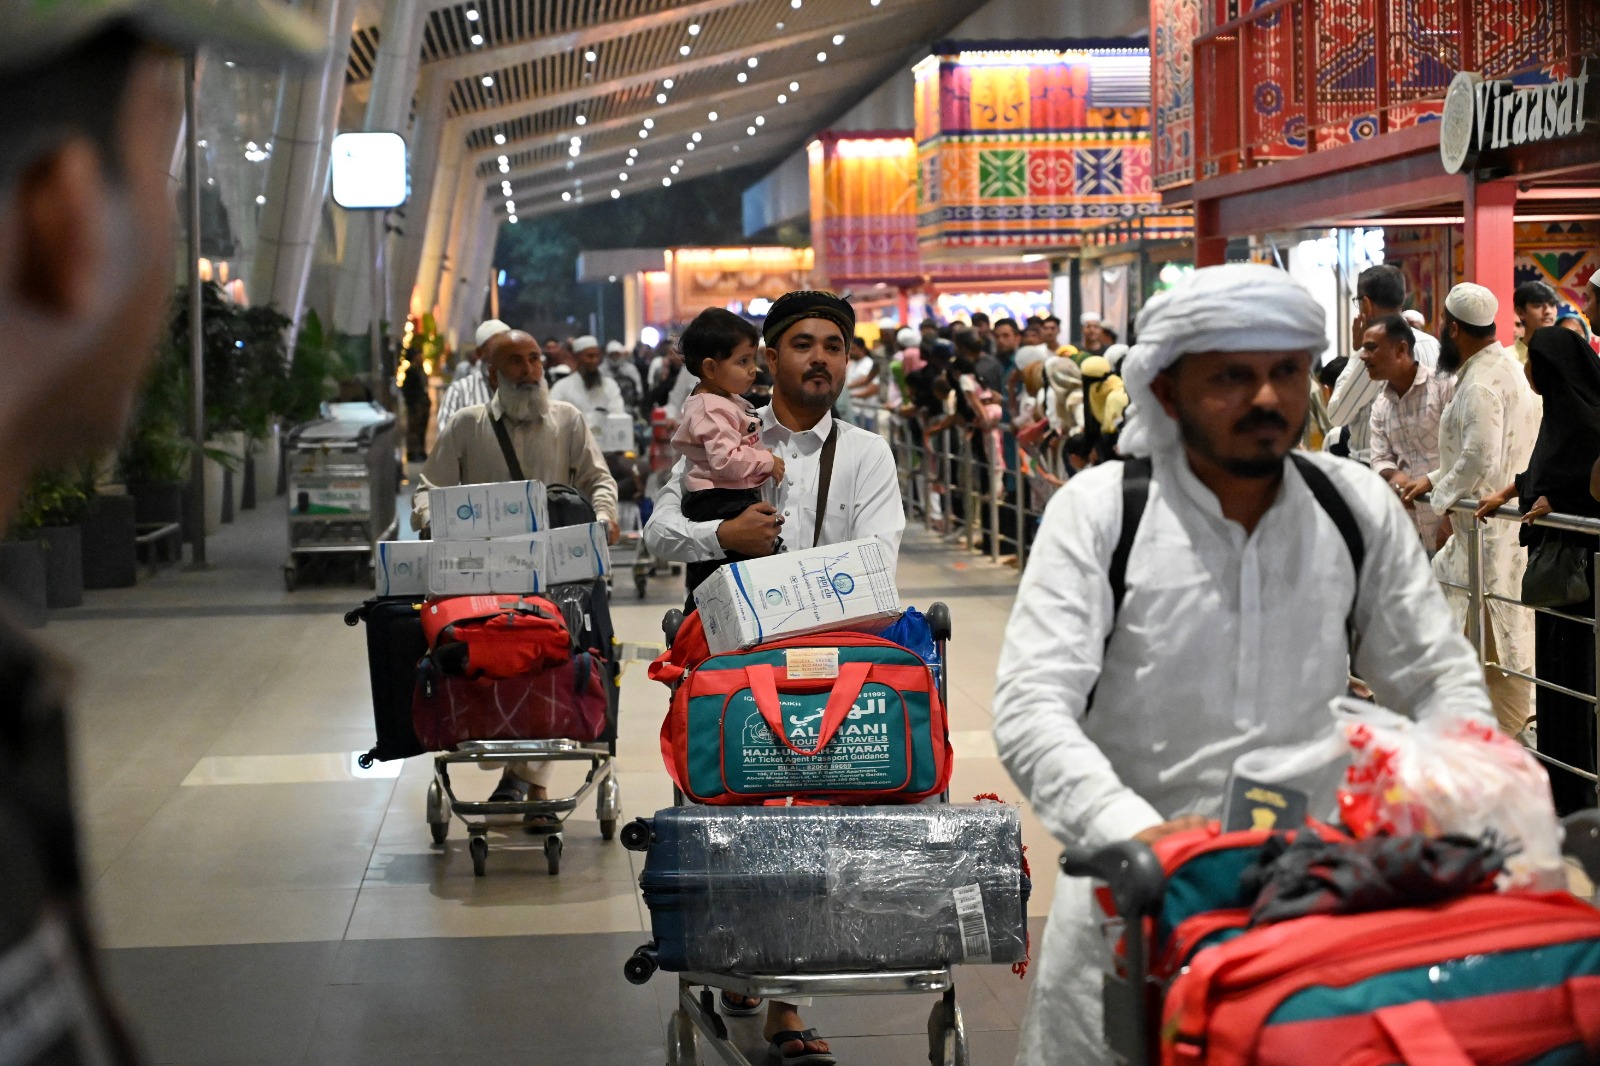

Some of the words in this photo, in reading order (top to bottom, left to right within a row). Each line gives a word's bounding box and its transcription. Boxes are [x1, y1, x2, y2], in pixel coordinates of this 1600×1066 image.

[1475, 57, 1589, 152] Viraasat
[841, 735, 889, 743] TRAVELS
[785, 755, 809, 764] Agent
[811, 754, 848, 763] Passport
[850, 752, 890, 760] Guidance
